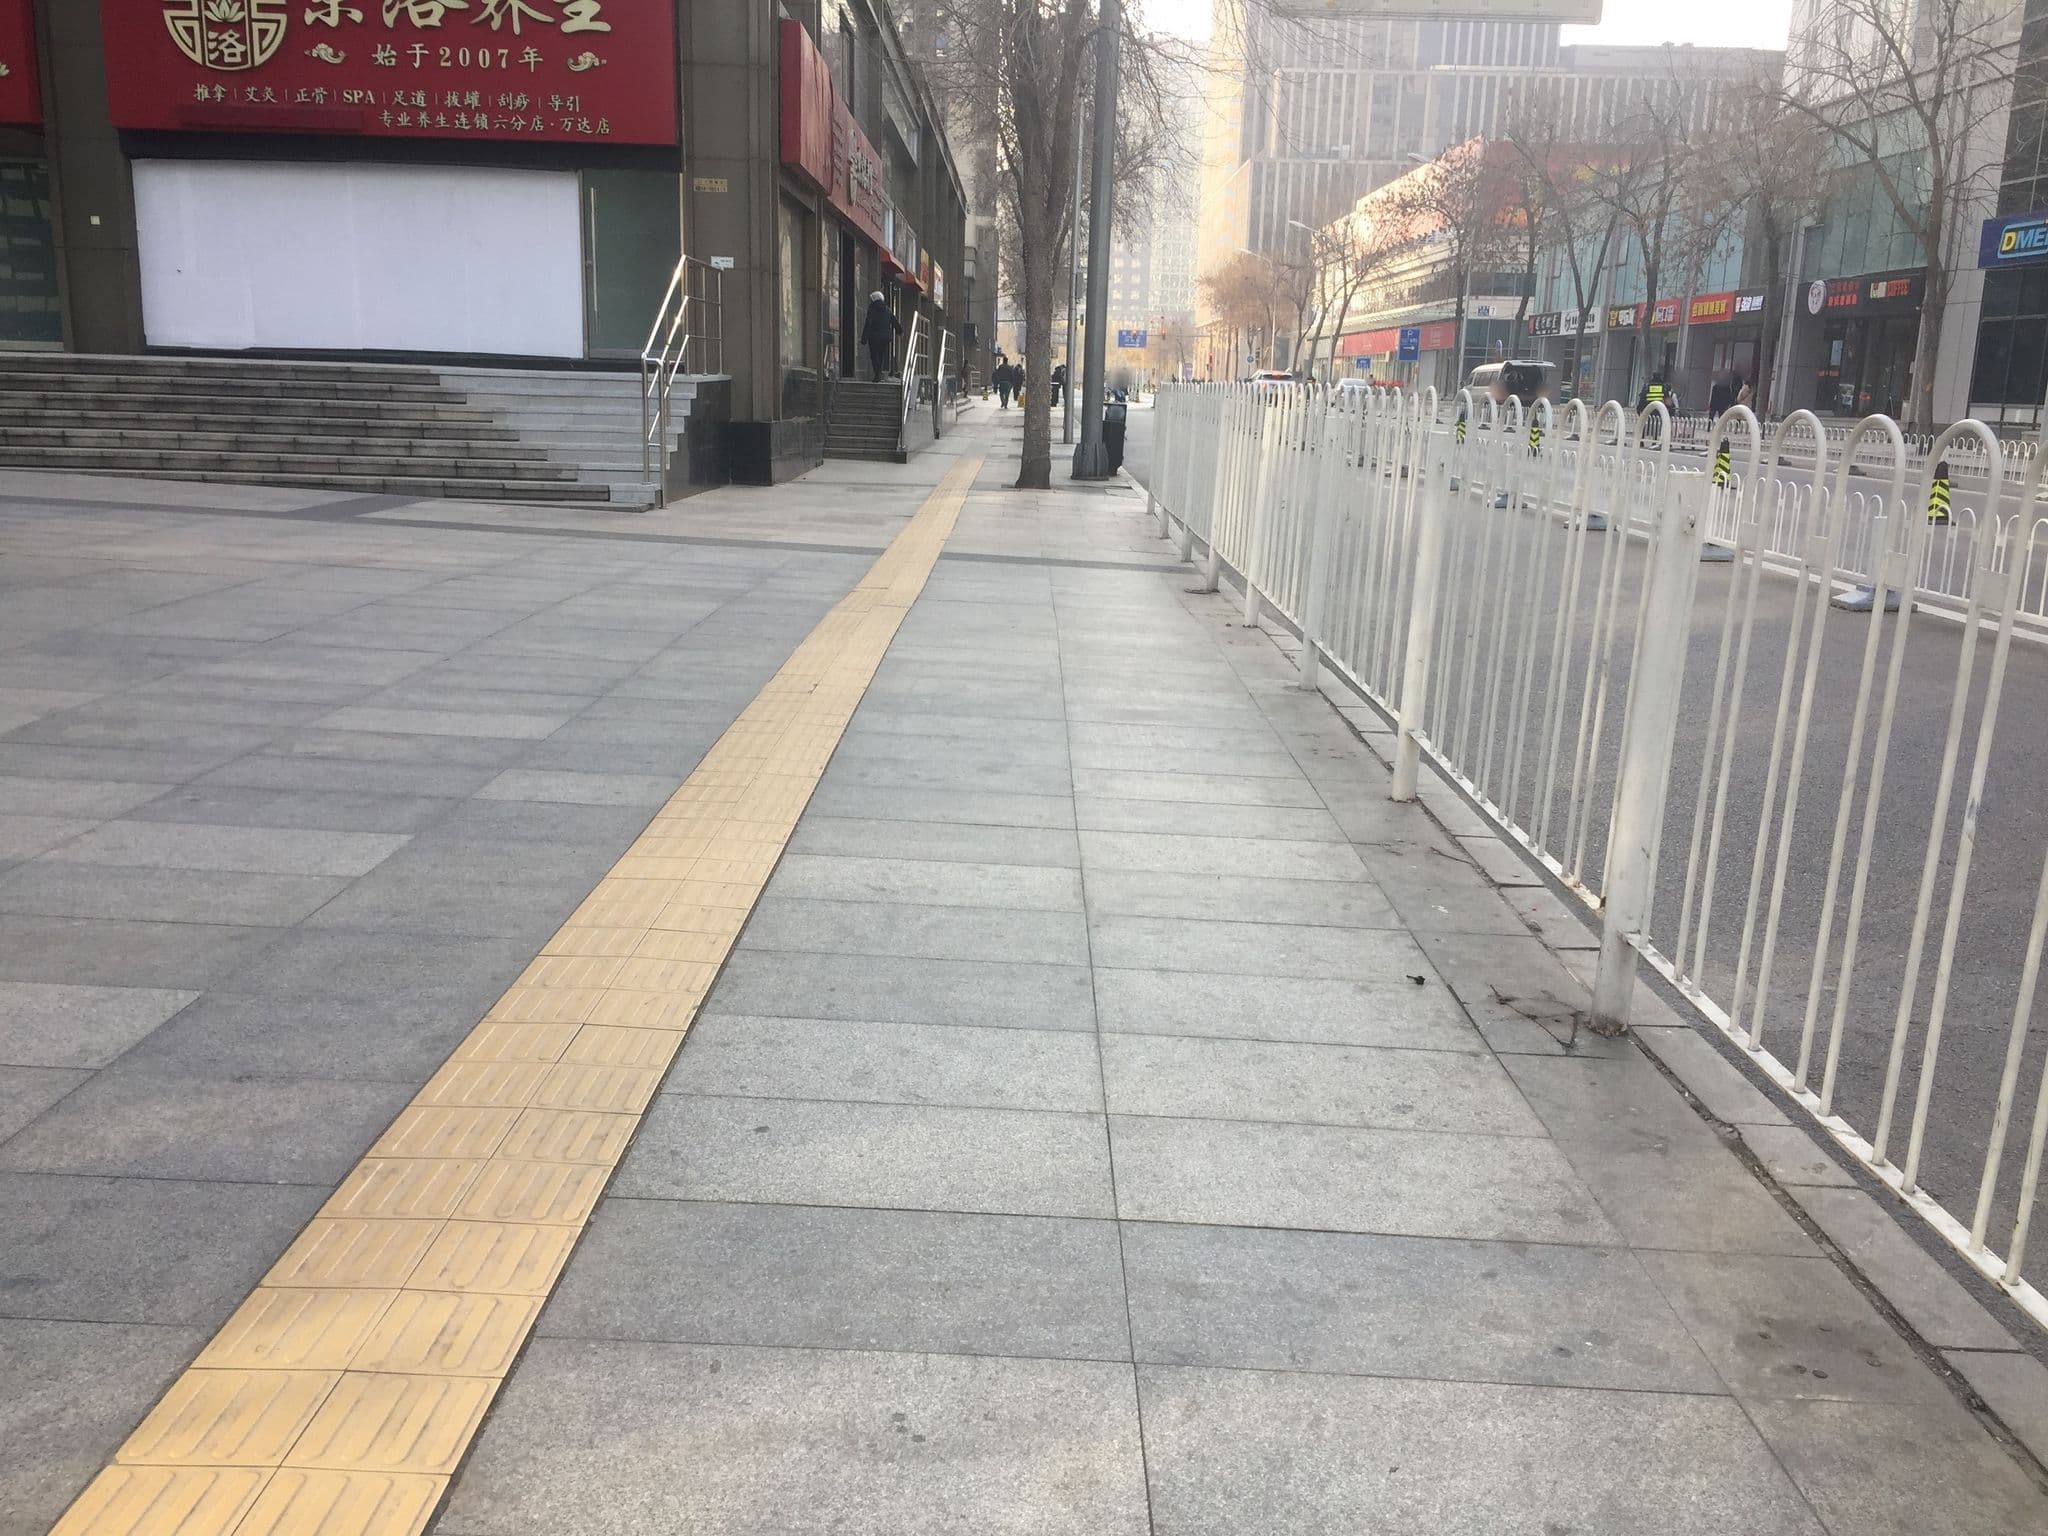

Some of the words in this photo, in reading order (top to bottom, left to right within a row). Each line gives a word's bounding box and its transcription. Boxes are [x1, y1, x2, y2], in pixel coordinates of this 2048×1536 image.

[207, 29, 247, 64] 洛
[371, 43, 544, 73] 始于2007年
[193, 83, 228, 103] 推拿
[245, 86, 279, 103] 艾灸
[296, 87, 328, 105] 正骨
[342, 89, 376, 105] SPA
[391, 90, 427, 108] 足道
[444, 91, 481, 110] 拔罐
[497, 92, 530, 112] 刮痧
[548, 94, 580, 113] 导引
[2001, 226, 2048, 252] DME
